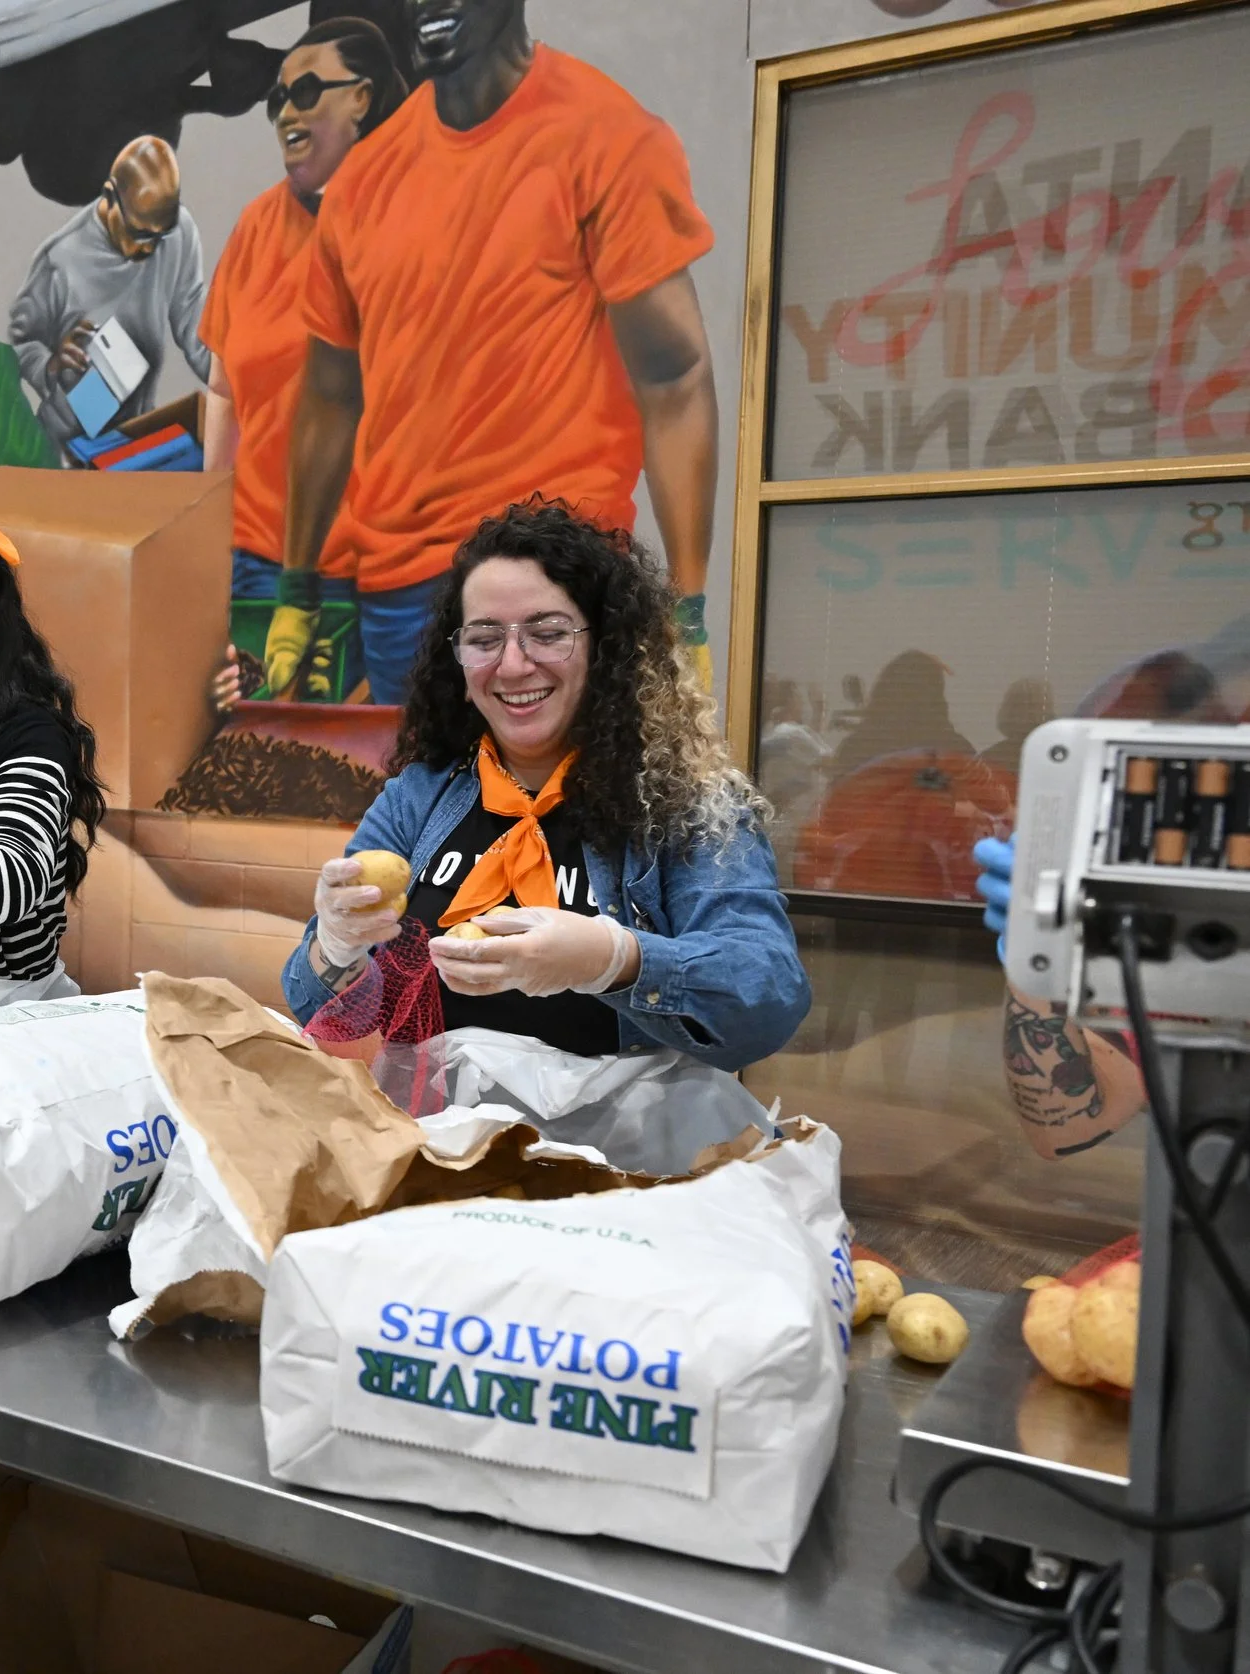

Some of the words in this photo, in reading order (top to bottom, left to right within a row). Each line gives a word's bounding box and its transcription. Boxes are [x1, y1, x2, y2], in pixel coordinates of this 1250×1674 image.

[452, 1211, 556, 1231] PRODUCE
[561, 1225, 591, 1235] OF
[380, 1302, 683, 1392] POTATOES
[356, 1346, 540, 1426] RIVER
[548, 1382, 699, 1454] PINE
